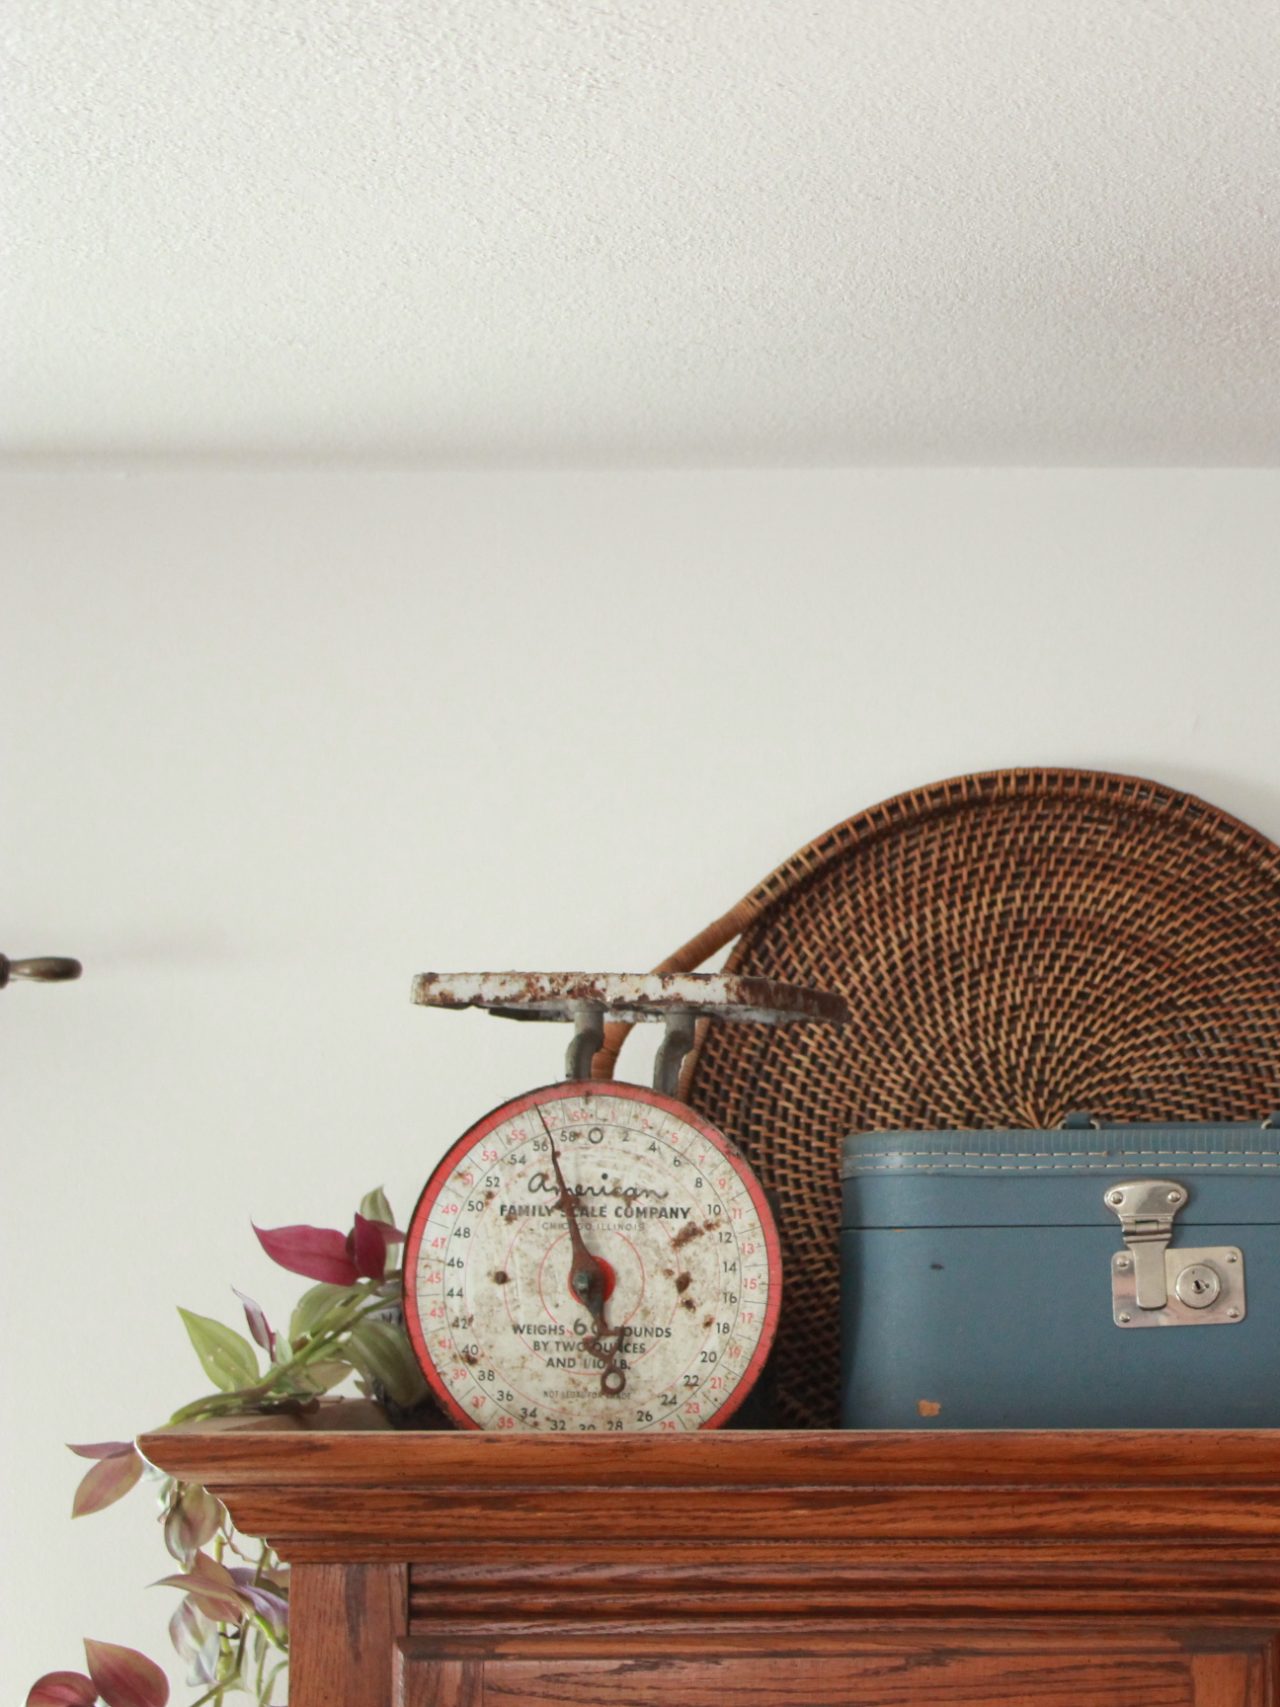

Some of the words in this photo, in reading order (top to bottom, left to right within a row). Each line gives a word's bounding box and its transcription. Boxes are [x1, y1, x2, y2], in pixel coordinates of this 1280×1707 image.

[510, 1130, 526, 1141] 55
[560, 1130, 576, 1142] 58
[622, 1131, 630, 1142] 2
[671, 1133, 679, 1143] 5
[533, 1141, 549, 1152] 56
[649, 1142, 657, 1153] 4
[482, 1150, 498, 1162] 53
[510, 1153, 527, 1165] 54
[673, 1156, 681, 1168] 6
[485, 1176, 501, 1188] 52
[528, 1172, 669, 1200] American
[695, 1177, 703, 1189] 8
[441, 1204, 459, 1214] 49
[467, 1200, 485, 1212] 50
[500, 1204, 556, 1217] FAMILY
[614, 1205, 692, 1220] COMPANY
[707, 1204, 722, 1216] 10
[453, 1227, 471, 1239] 48
[718, 1232, 733, 1244] 12
[446, 1257, 465, 1269] 46
[723, 1261, 737, 1273] 14
[425, 1273, 442, 1284] 45
[743, 1278, 758, 1290] 15
[446, 1287, 464, 1298] 44
[723, 1292, 738, 1304] 16
[451, 1316, 469, 1329] 42
[716, 1322, 731, 1334] 18
[512, 1324, 566, 1336] WEIGHS
[614, 1326, 673, 1338] OUNDS
[461, 1344, 479, 1356] 40
[533, 1341, 549, 1351] BY
[554, 1341, 585, 1352] TWO
[546, 1357, 576, 1368] AND
[700, 1351, 717, 1363] 20
[452, 1368, 467, 1380] 39
[478, 1370, 495, 1382] 38
[683, 1375, 699, 1387] 22
[710, 1377, 722, 1389] 21
[497, 1390, 514, 1402] 36
[661, 1394, 677, 1406] 24
[520, 1407, 537, 1419] 34
[686, 1403, 700, 1414] 23
[637, 1410, 653, 1422] 26
[497, 1417, 514, 1429] 35
[550, 1419, 566, 1431] 32
[607, 1420, 623, 1431] 28
